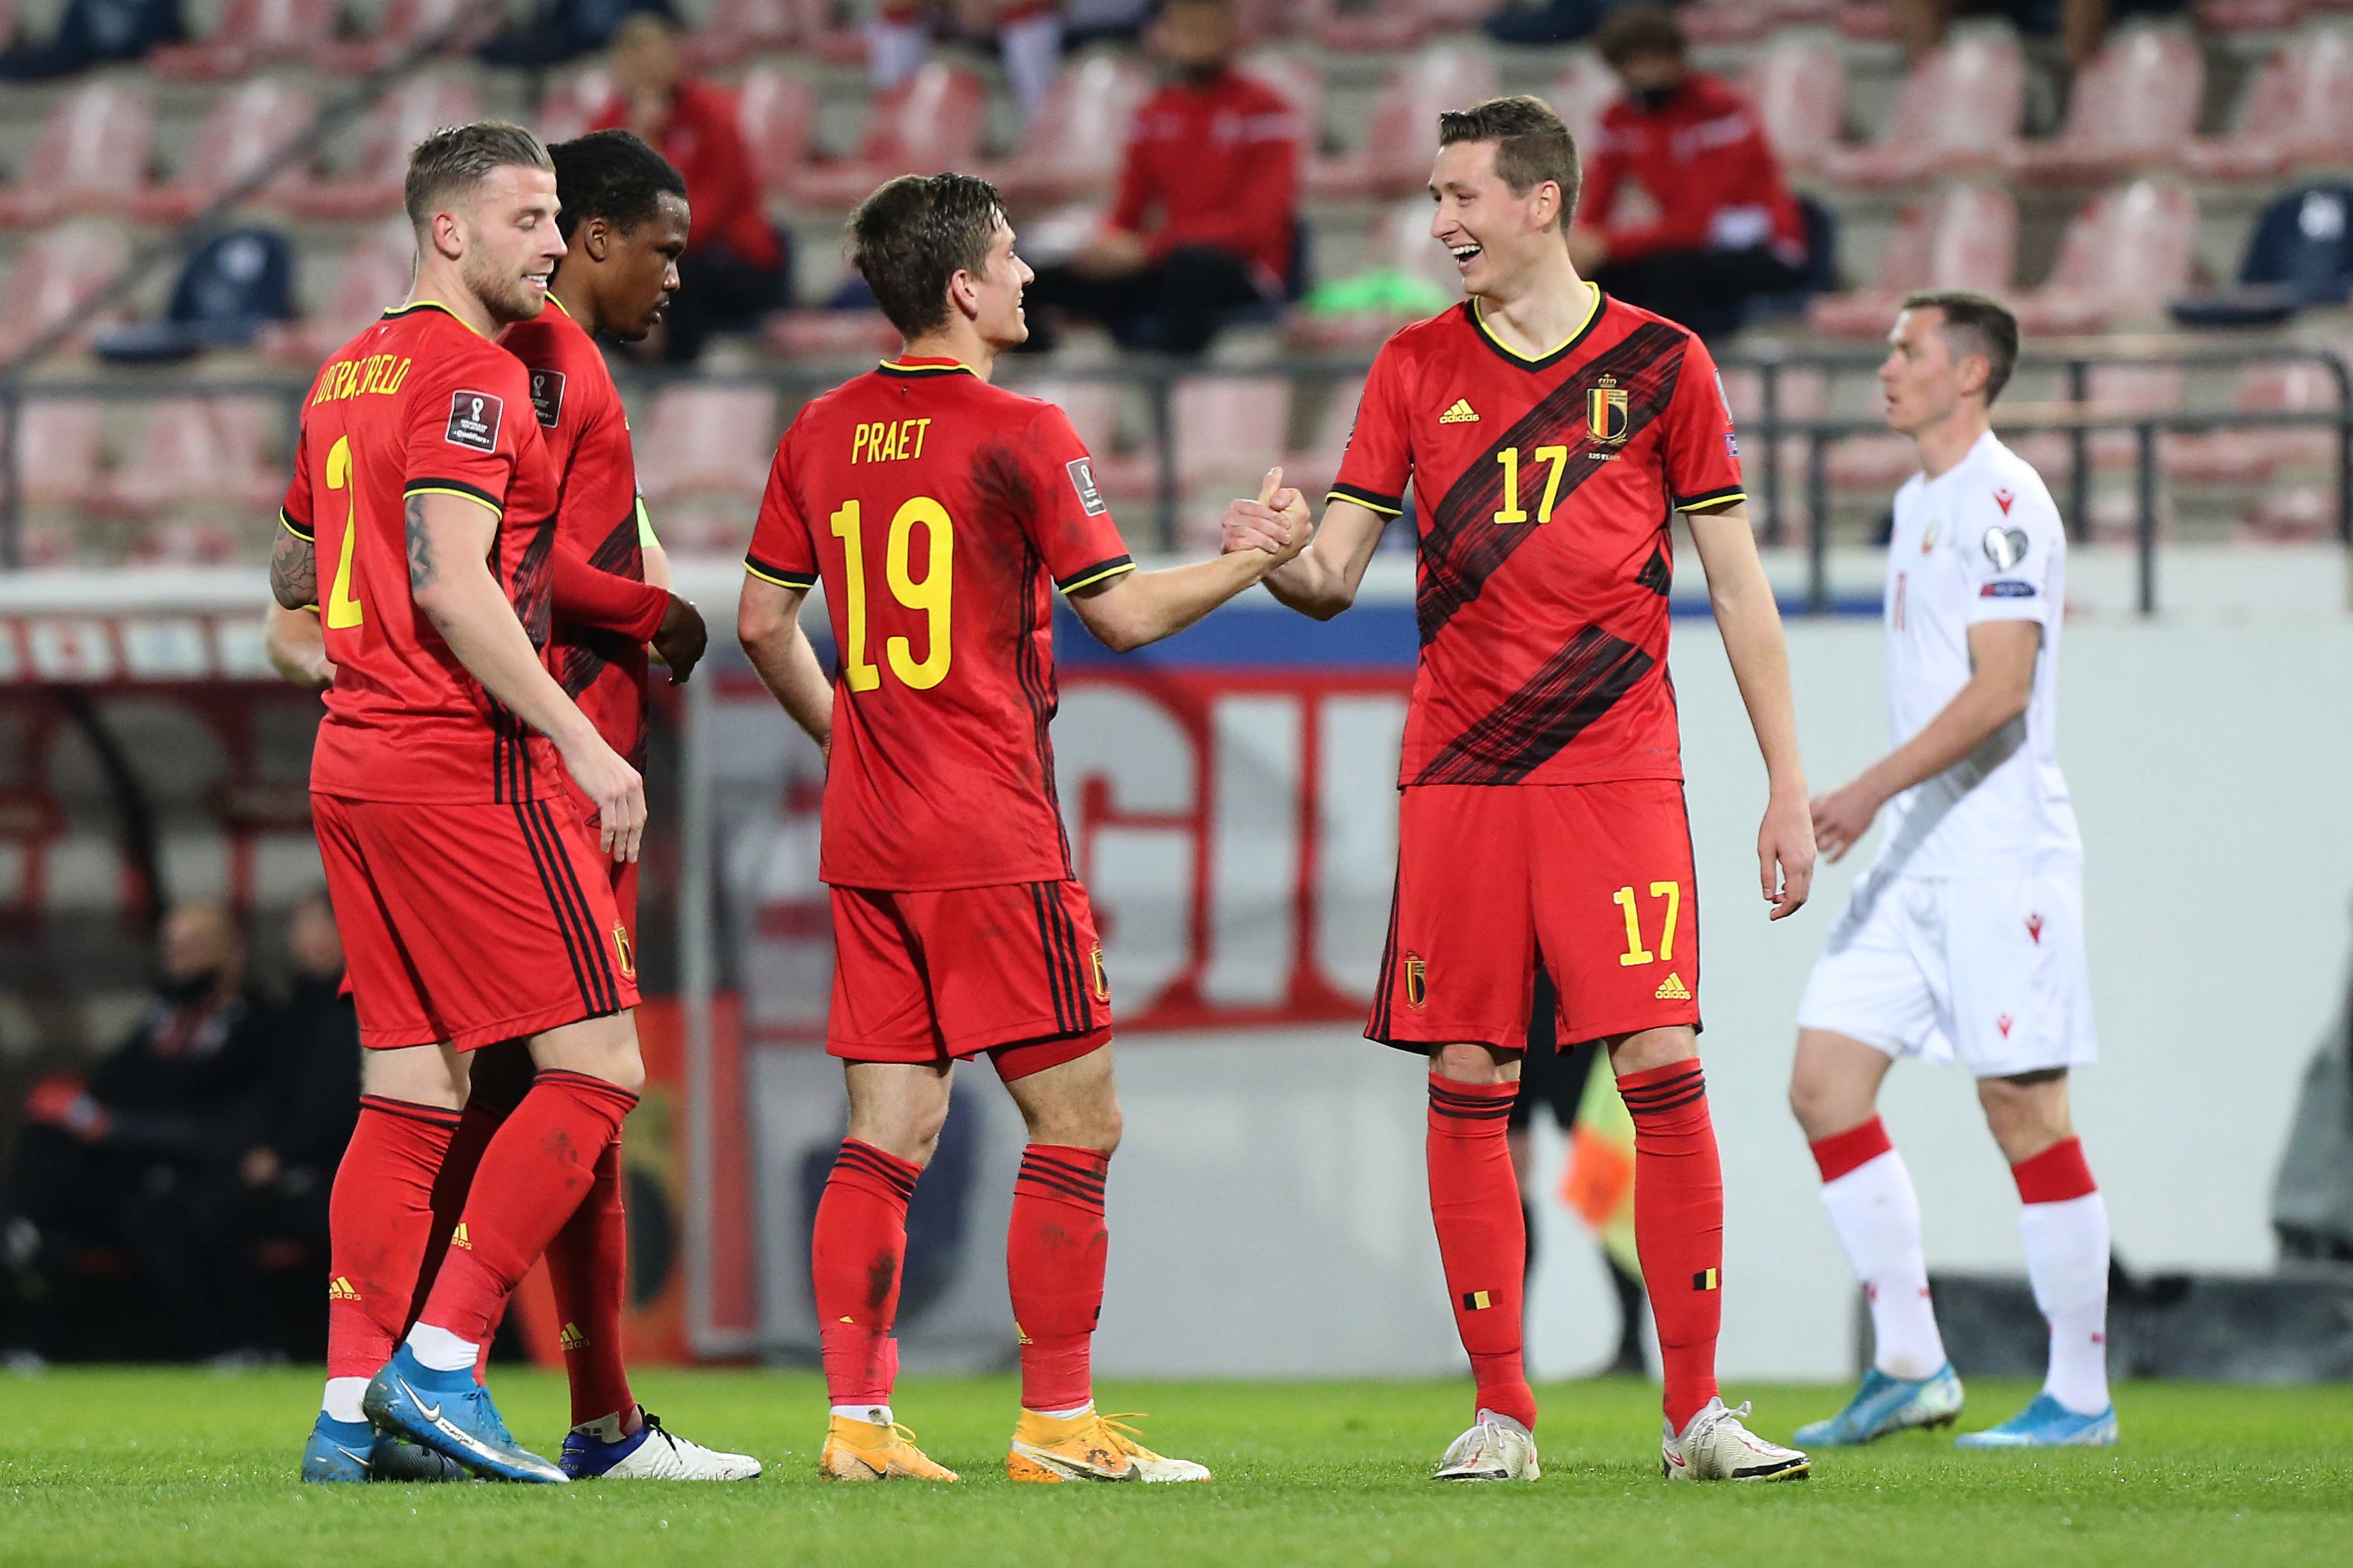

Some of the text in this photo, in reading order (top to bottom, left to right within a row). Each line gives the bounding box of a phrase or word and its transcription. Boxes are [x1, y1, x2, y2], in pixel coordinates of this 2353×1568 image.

[851, 418, 931, 465] PRAET
[1439, 413, 1480, 424] adidas
[1494, 445, 1568, 524] 17
[326, 435, 363, 629] 2
[830, 497, 954, 693] 19
[1613, 881, 1681, 966] 17
[1655, 989, 1692, 1000] adidas
